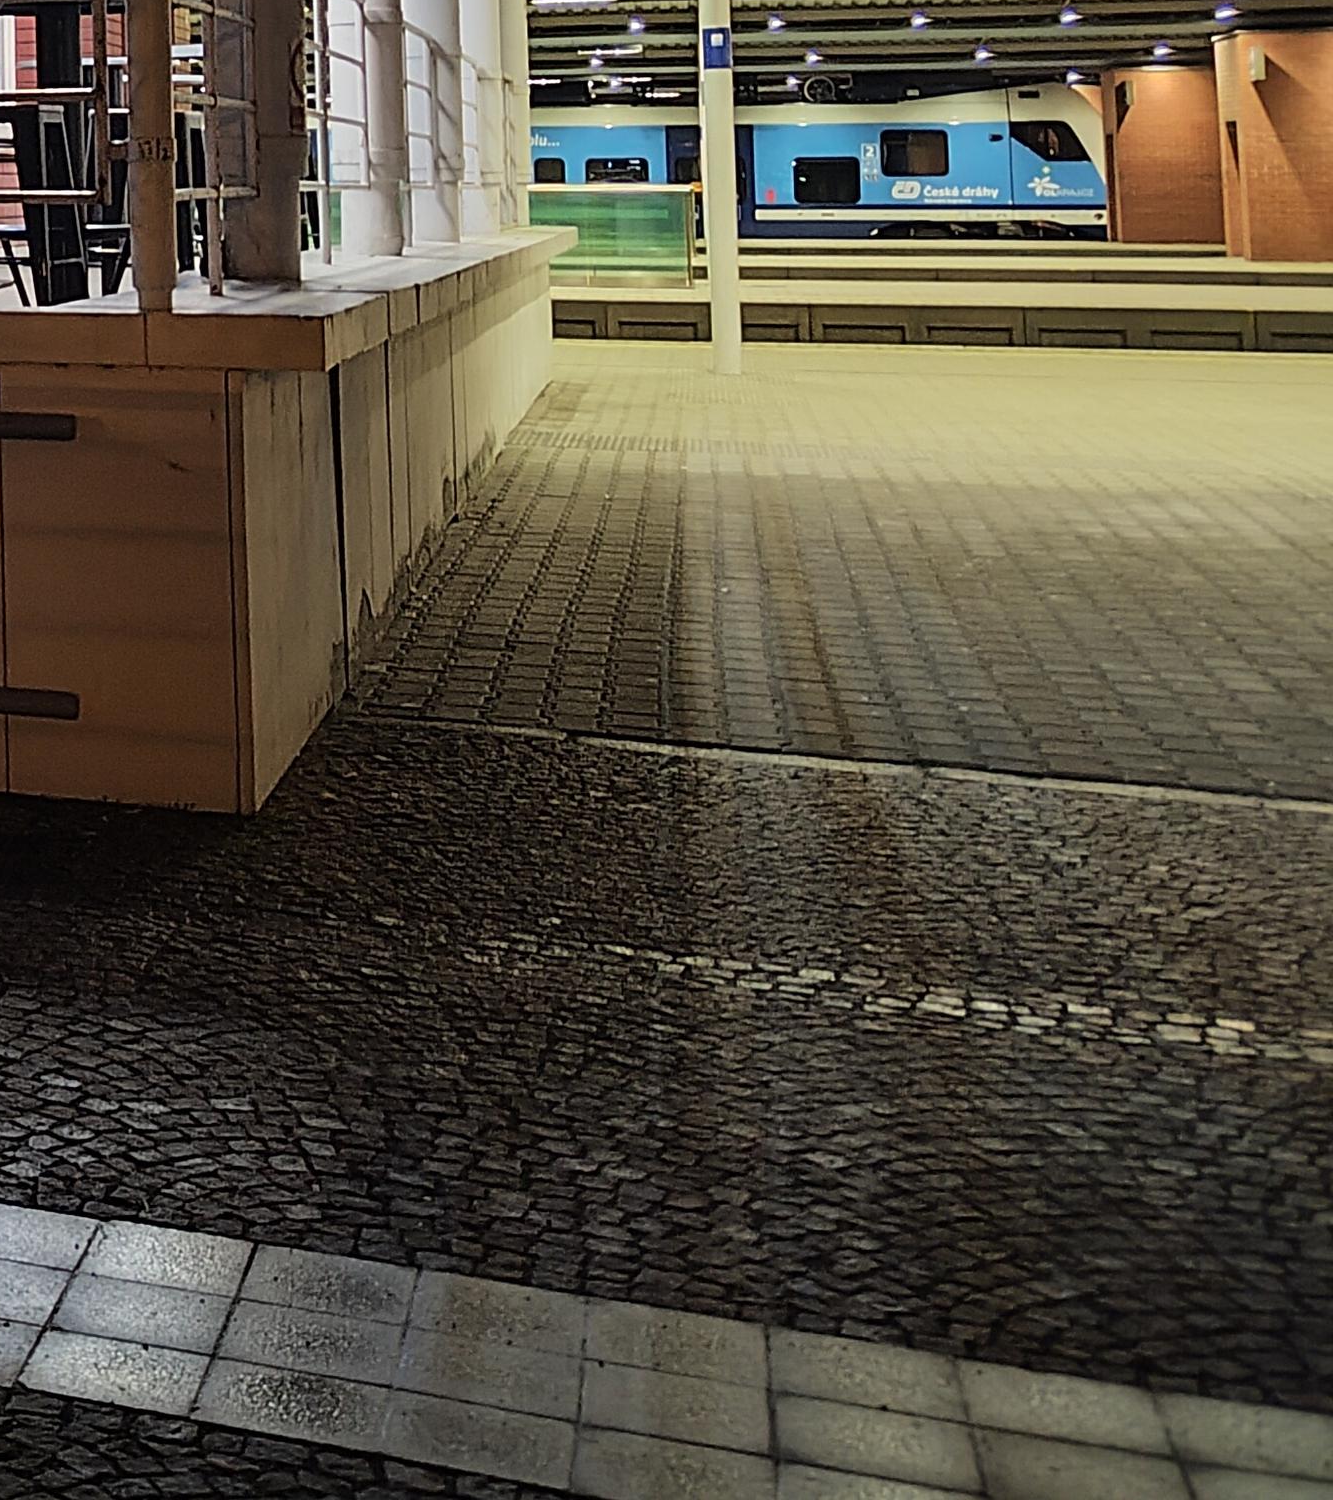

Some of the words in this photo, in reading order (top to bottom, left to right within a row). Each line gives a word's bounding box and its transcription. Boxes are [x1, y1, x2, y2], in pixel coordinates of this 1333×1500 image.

[865, 145, 874, 157] 2
[923, 180, 959, 197] České
[962, 181, 999, 199] dráhy
